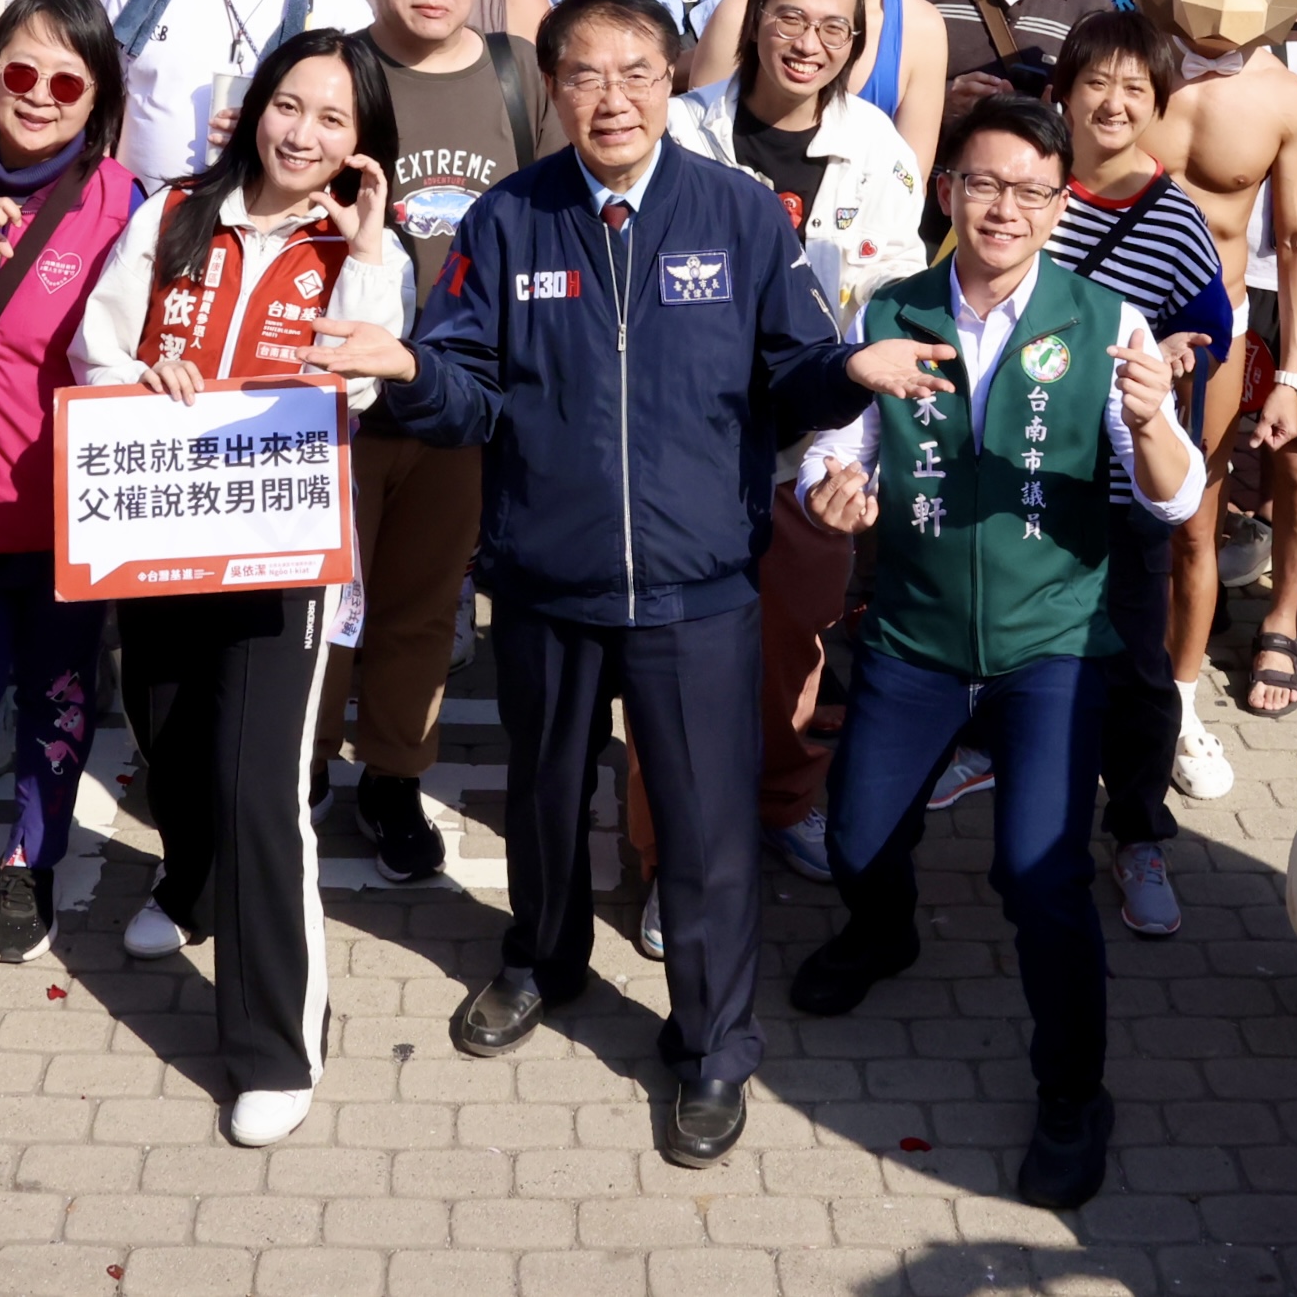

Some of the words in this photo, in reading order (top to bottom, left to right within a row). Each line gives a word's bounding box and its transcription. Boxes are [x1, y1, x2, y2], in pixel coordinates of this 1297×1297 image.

[395, 148, 497, 186] EXTREME
[423, 176, 468, 187] ADVENTURE
[206, 251, 225, 284] 永康區
[516, 270, 580, 301] C-130H
[190, 289, 216, 350] 議員參選人
[76, 430, 331, 477] 老娘就要出來選
[1020, 385, 1050, 541] 台南市議員
[77, 474, 332, 524] 父權說教男閉嘴
[147, 568, 195, 583] 台灣基進
[304, 599, 317, 650] BROOKLYN
